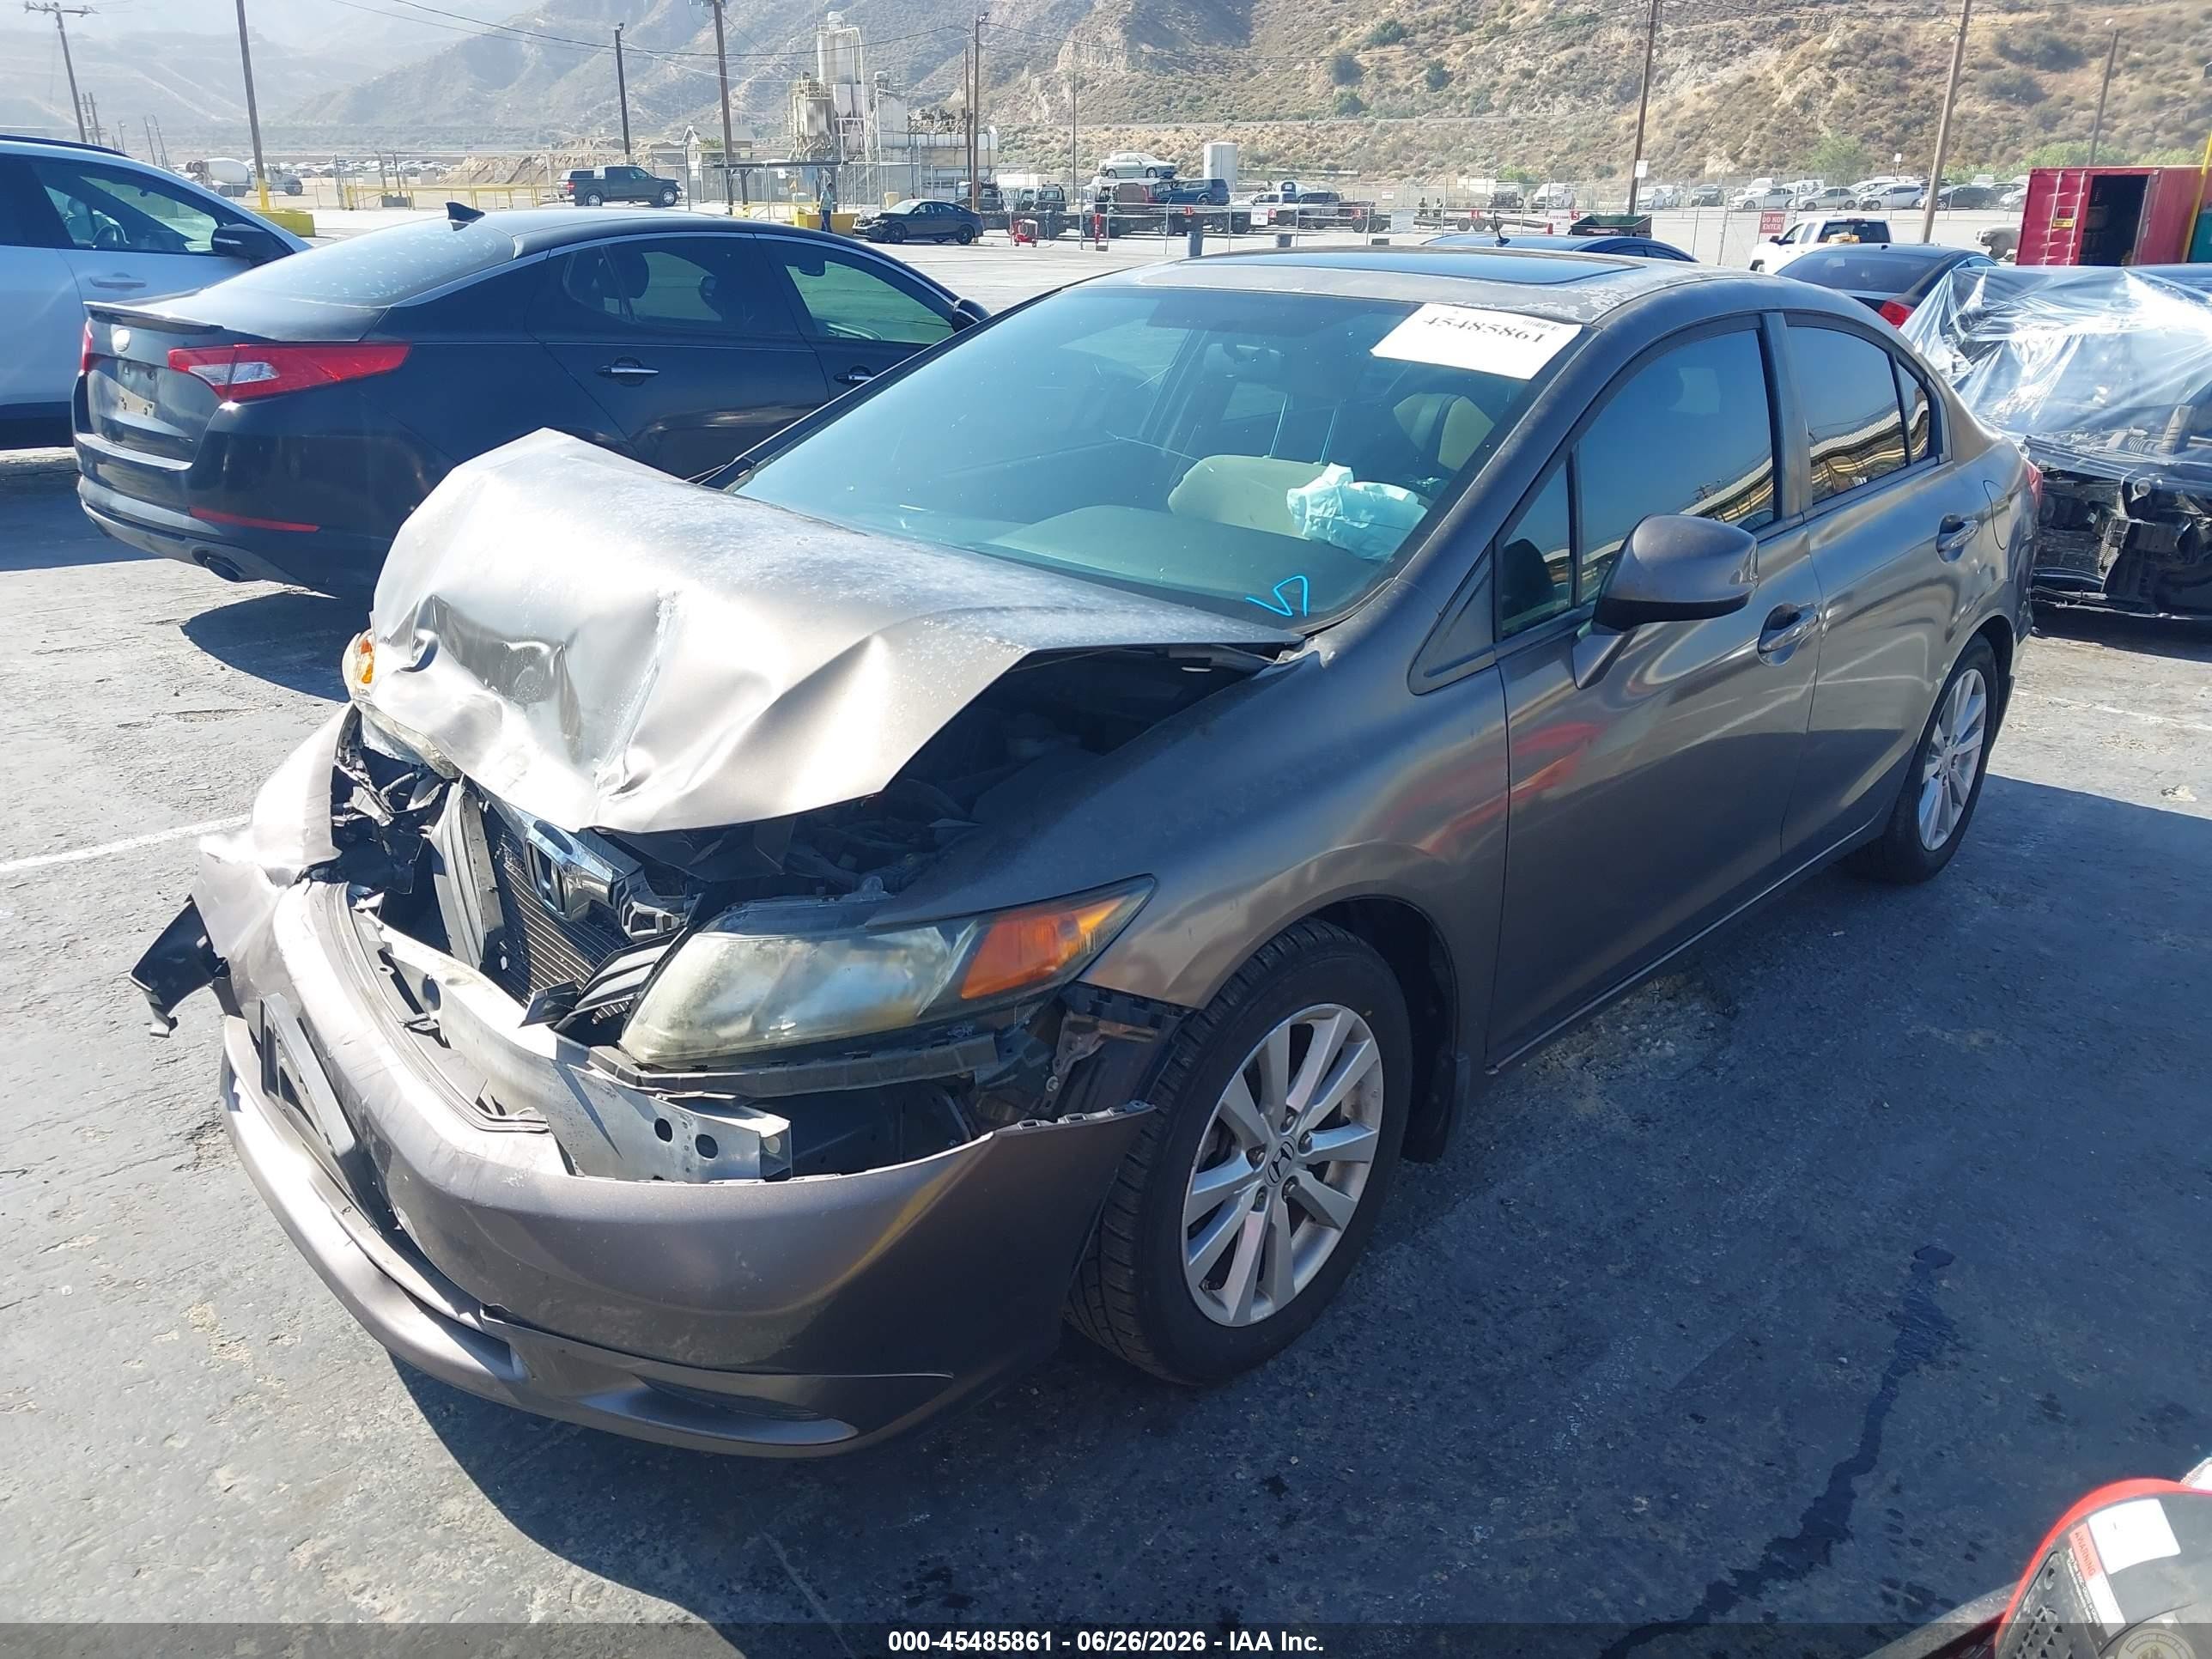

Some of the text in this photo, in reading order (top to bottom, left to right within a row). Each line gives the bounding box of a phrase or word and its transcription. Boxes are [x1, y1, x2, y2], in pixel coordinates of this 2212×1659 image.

[1573, 210, 1579, 220] 5
[1423, 316, 1547, 343] 45485861
[2075, 1535, 2096, 1577] WARNING
